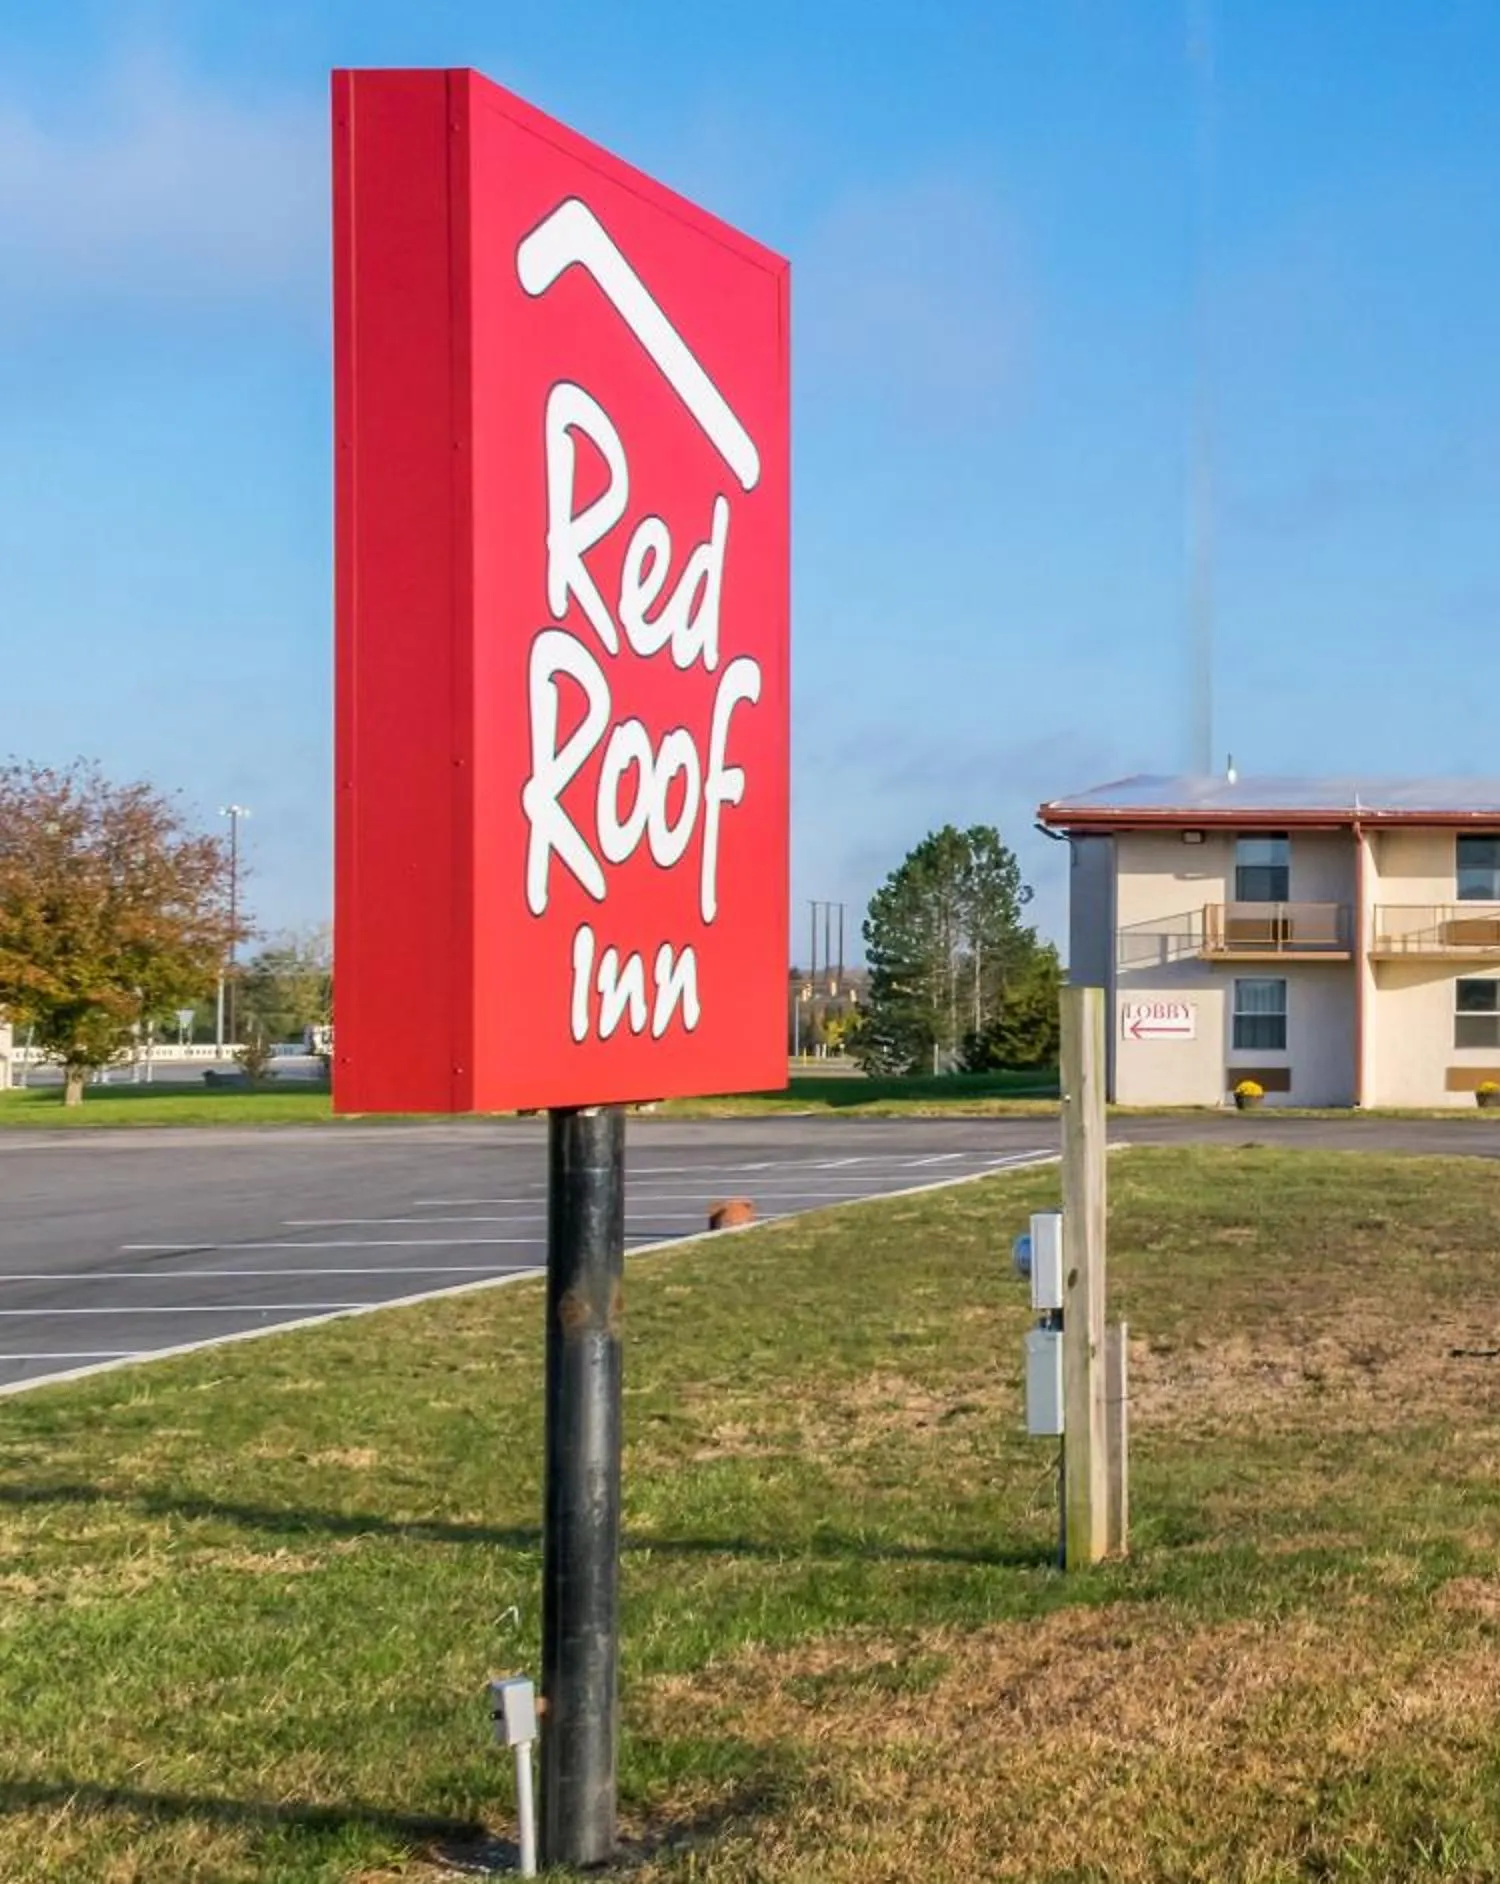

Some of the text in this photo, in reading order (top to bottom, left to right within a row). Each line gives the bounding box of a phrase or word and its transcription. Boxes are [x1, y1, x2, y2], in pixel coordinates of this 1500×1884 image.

[544, 381, 730, 672] Red
[521, 628, 762, 924] Roof
[570, 924, 701, 1042] Inn
[1126, 1002, 1194, 1019] LOBBY
